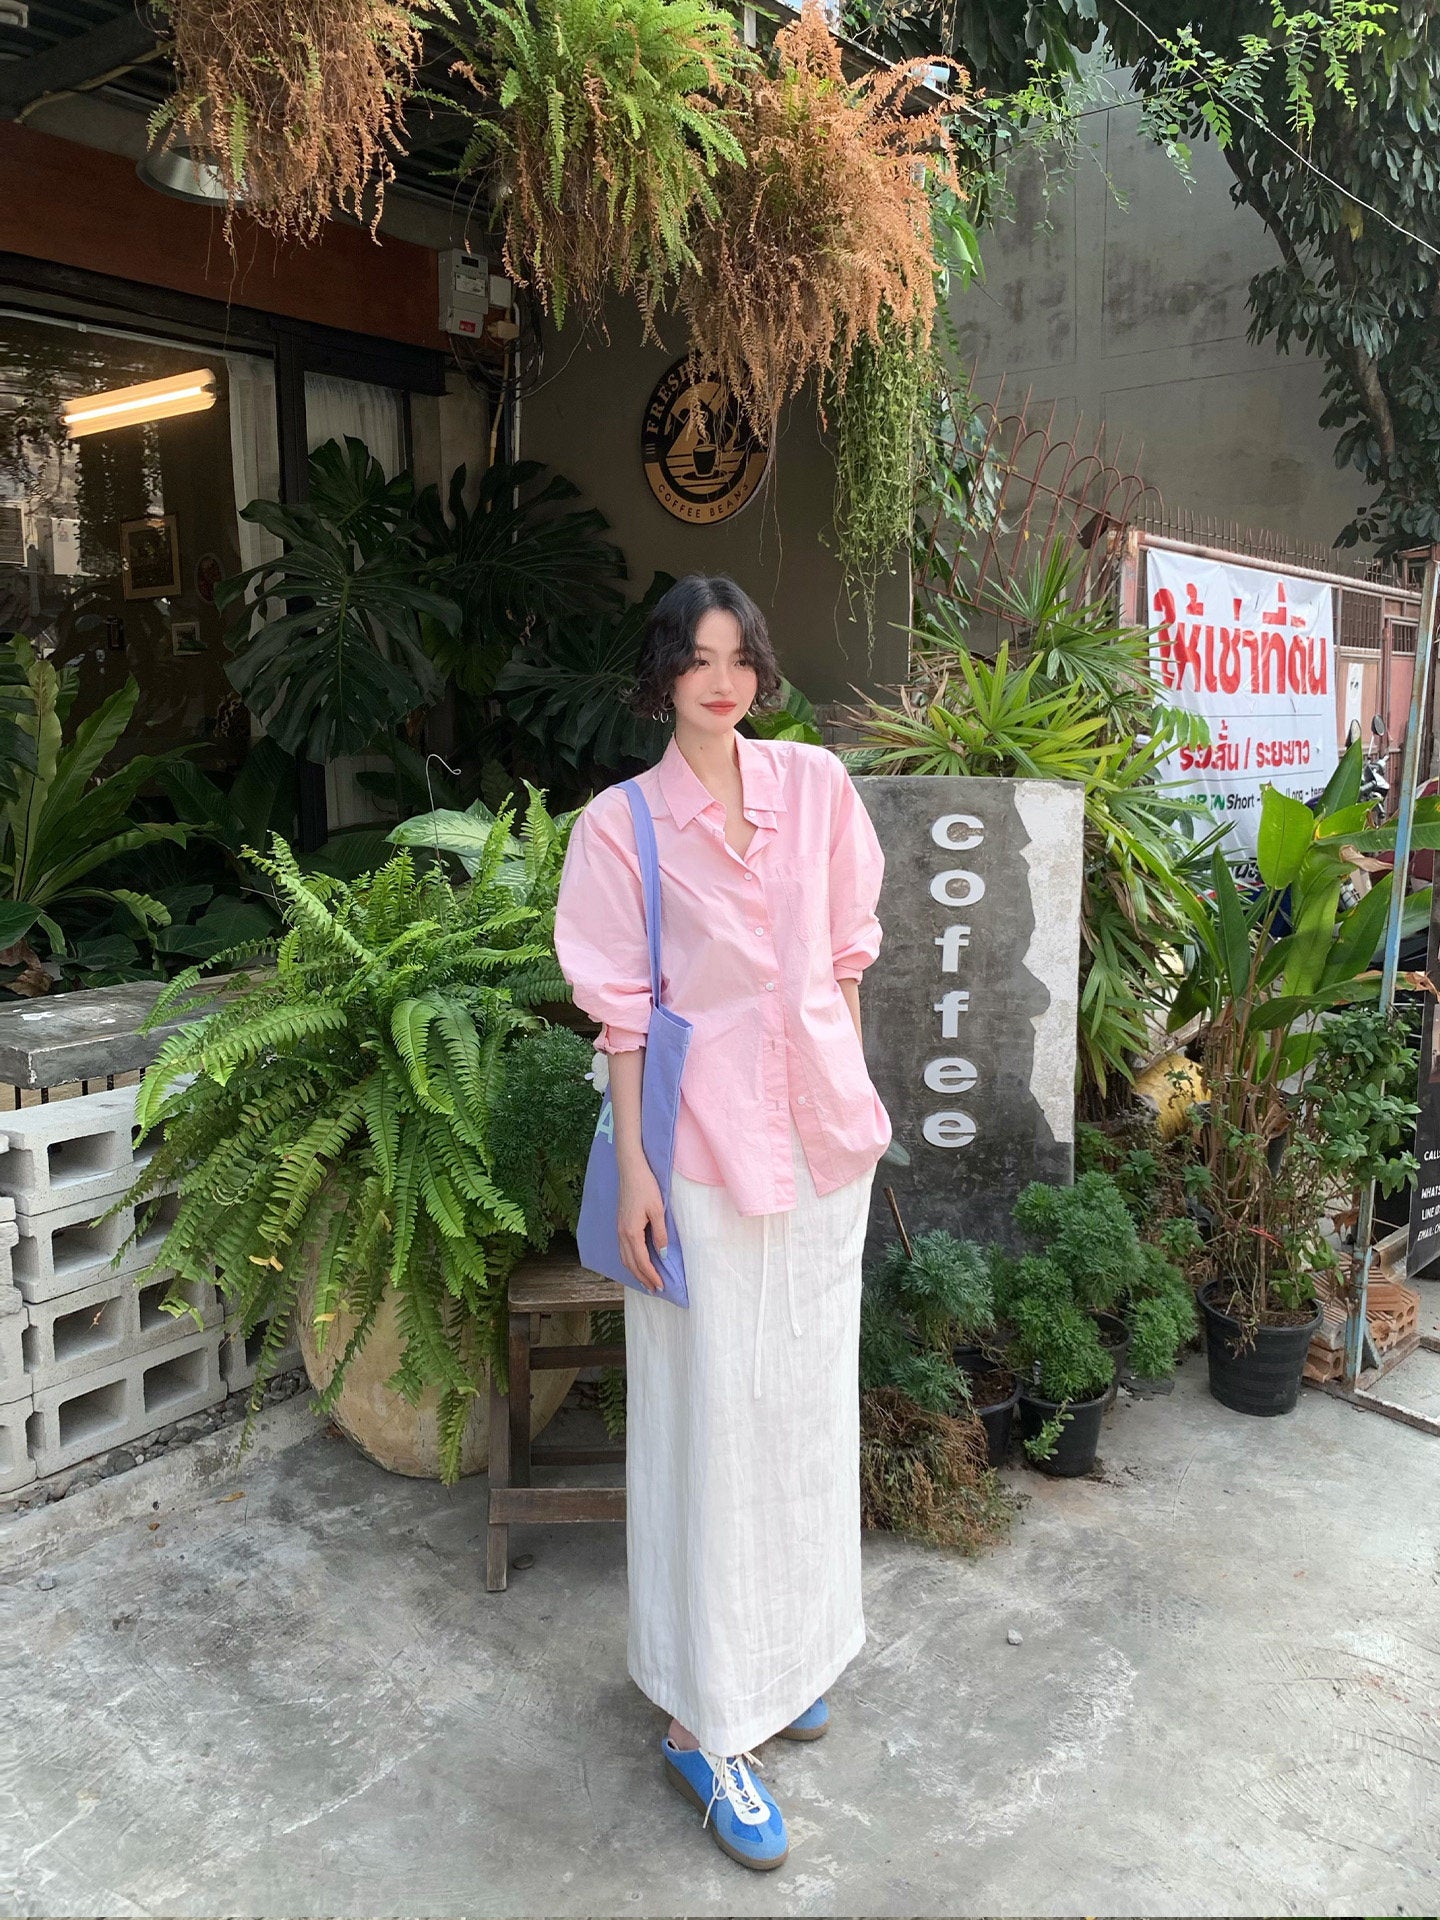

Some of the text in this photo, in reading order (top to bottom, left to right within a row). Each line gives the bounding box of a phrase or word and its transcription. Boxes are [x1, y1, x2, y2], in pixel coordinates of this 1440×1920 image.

[658, 484, 748, 518] COFFEE BEANS
[1256, 739, 1310, 768] ระยะยาว
[1226, 792, 1254, 810] Short
[922, 813, 985, 1148] coffee
